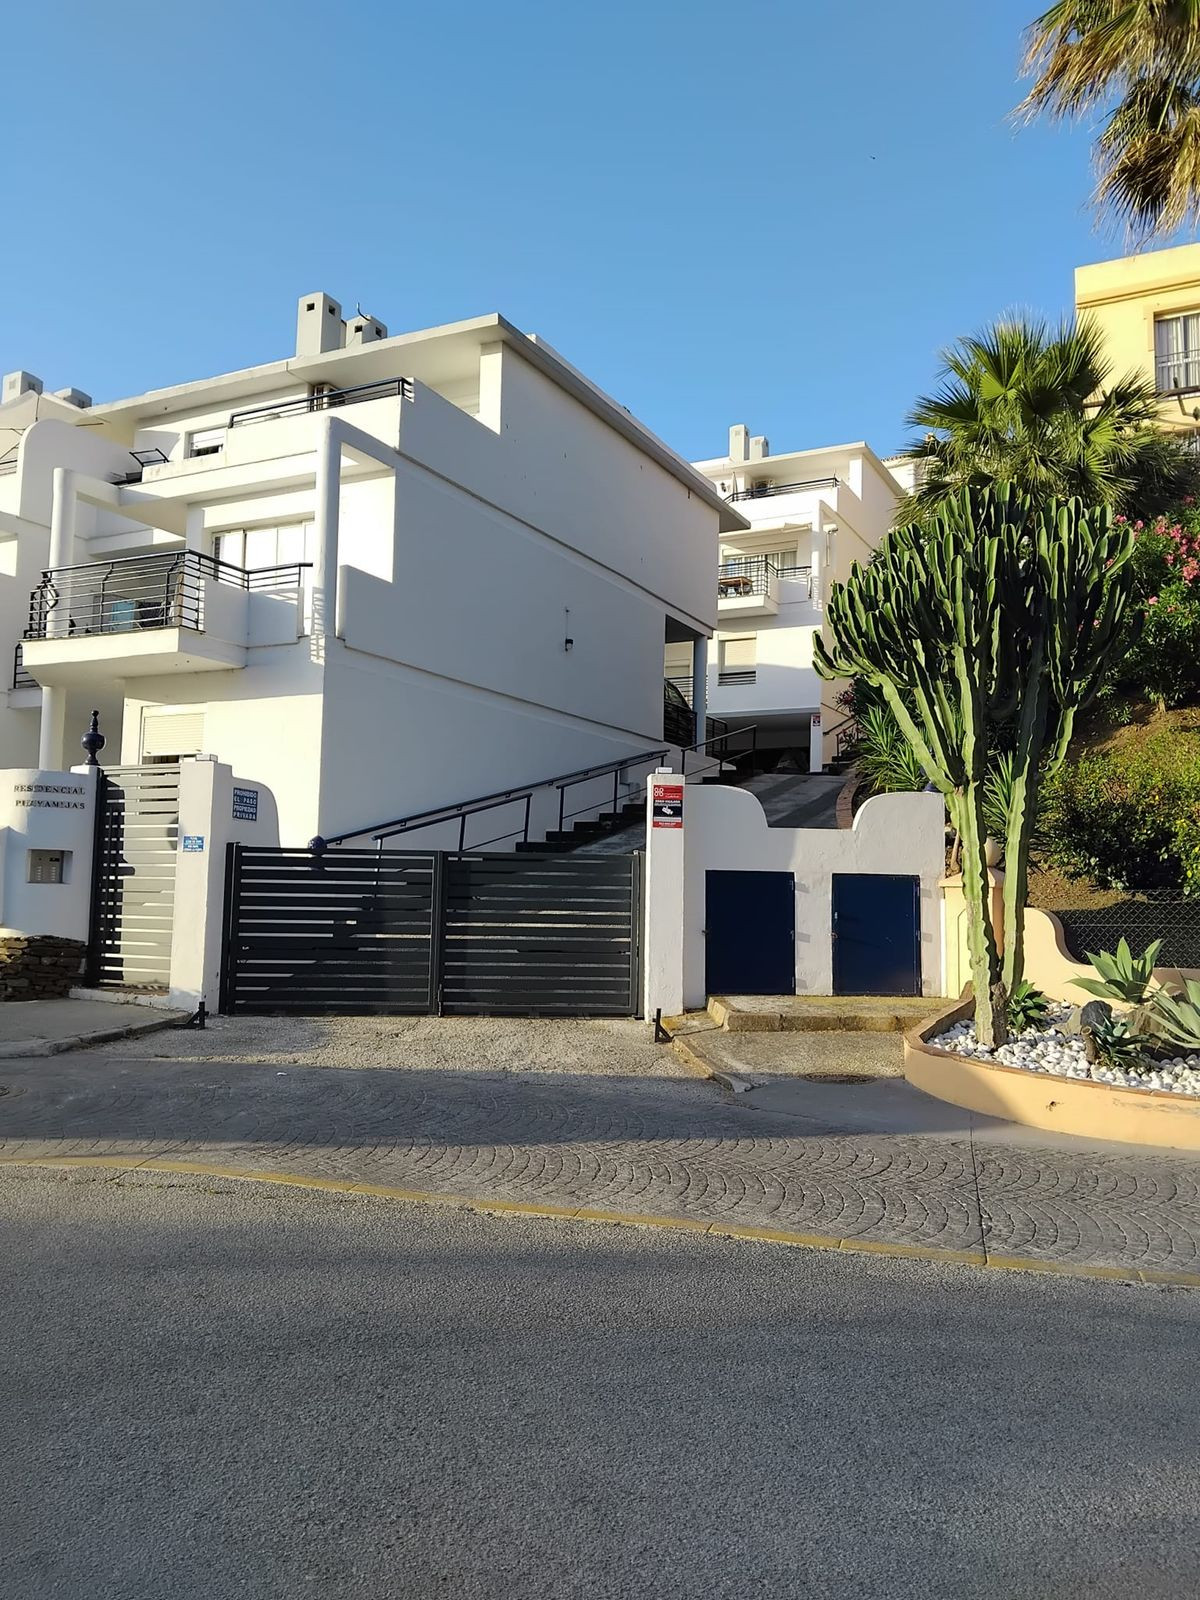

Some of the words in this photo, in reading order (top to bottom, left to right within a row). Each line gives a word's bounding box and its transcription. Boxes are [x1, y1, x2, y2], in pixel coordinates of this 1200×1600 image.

[14, 784, 86, 795] RESIDENCIAL
[243, 797, 257, 805] PASO
[233, 811, 256, 820] PRIVADA
